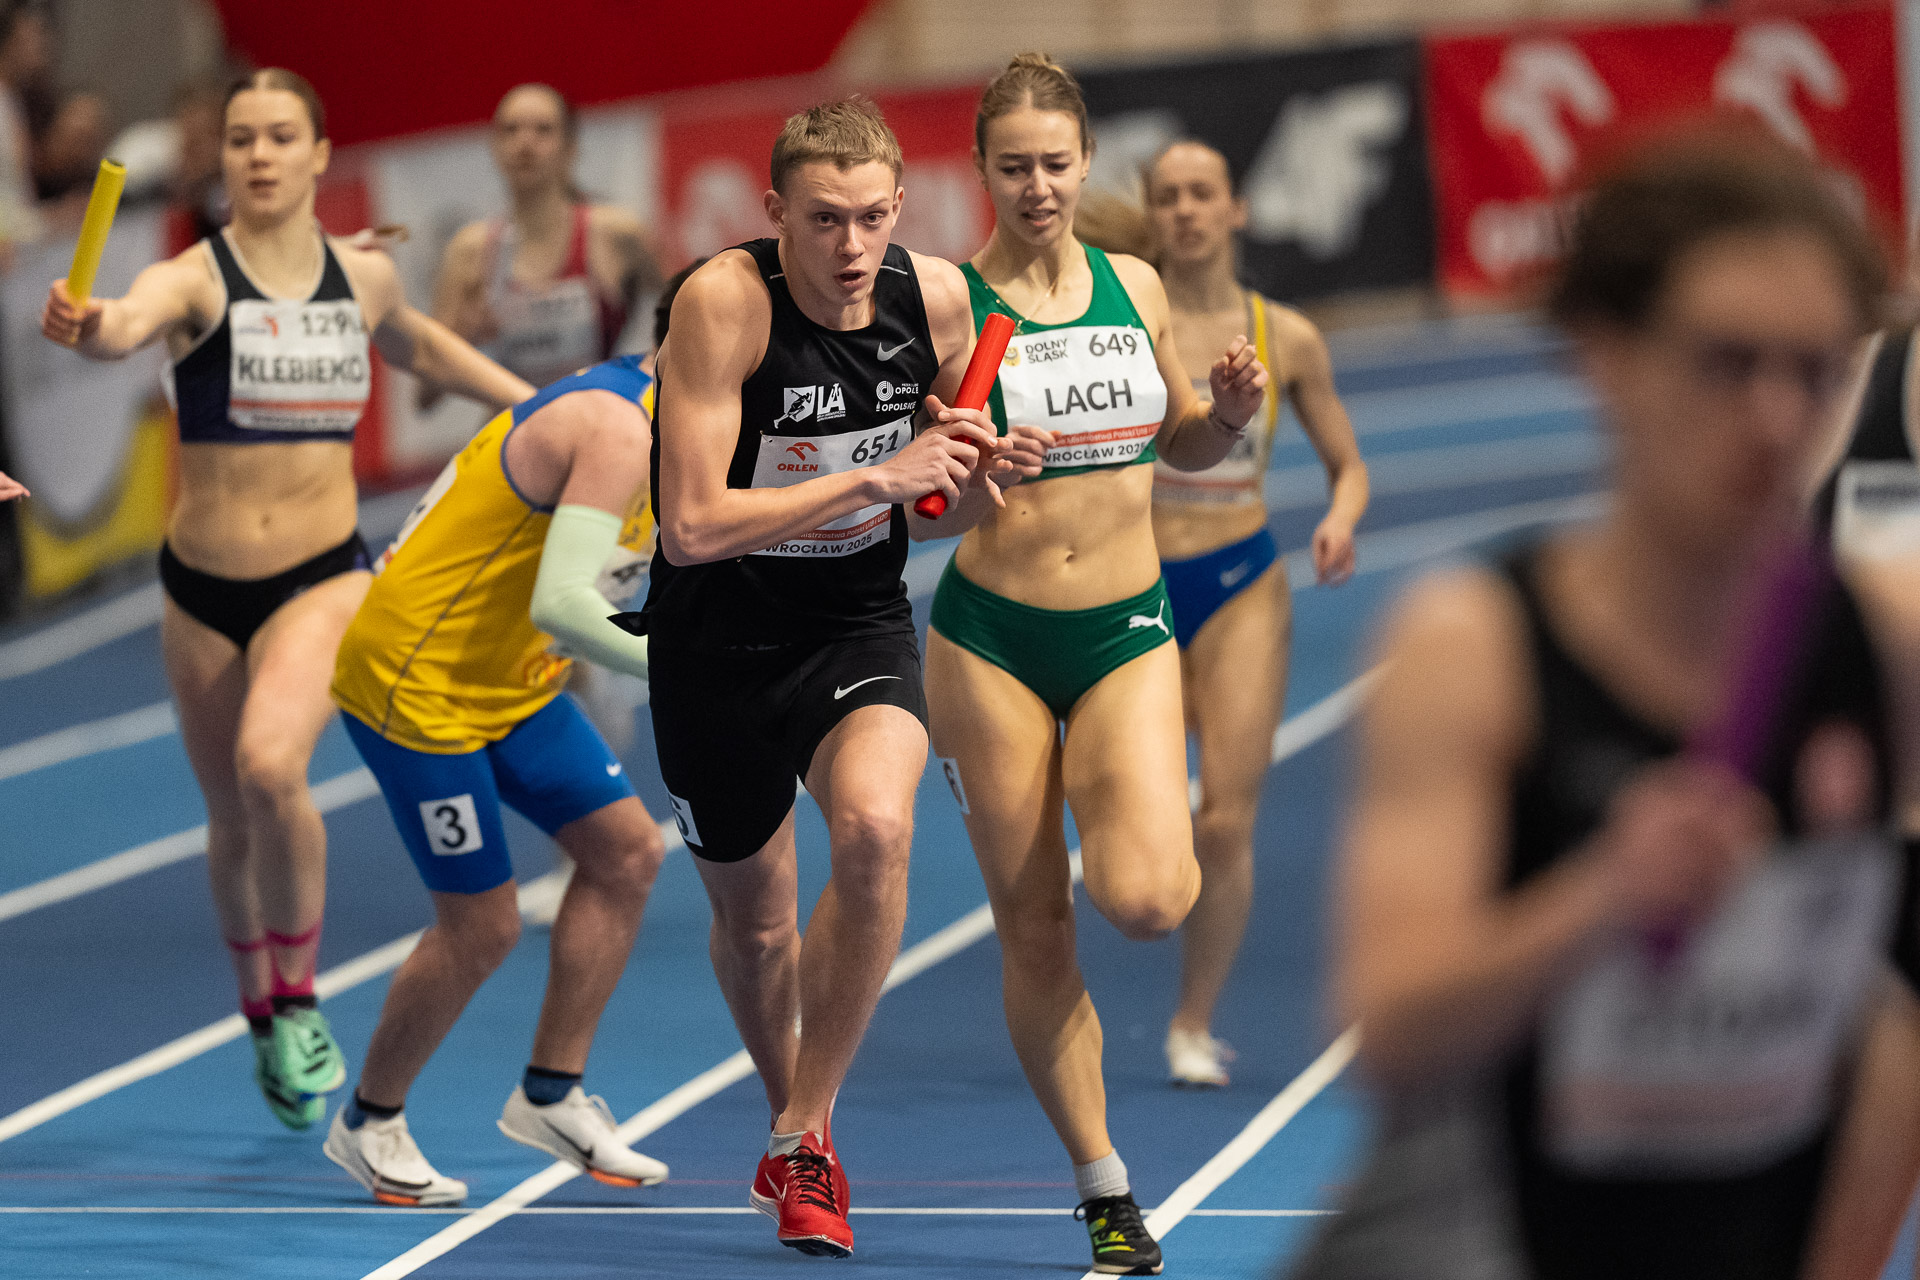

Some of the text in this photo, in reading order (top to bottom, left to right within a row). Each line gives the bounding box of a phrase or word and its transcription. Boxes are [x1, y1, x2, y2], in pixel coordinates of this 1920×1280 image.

[1025, 338, 1068, 354] DOLNY
[1089, 333, 1137, 357] 649
[895, 386, 919, 394] OPOLE
[1044, 378, 1133, 417] LACH
[851, 429, 899, 464] 651
[777, 463, 818, 472] ORLEN
[765, 533, 873, 555] WROCŁAW 2025
[434, 804, 466, 849] 3
